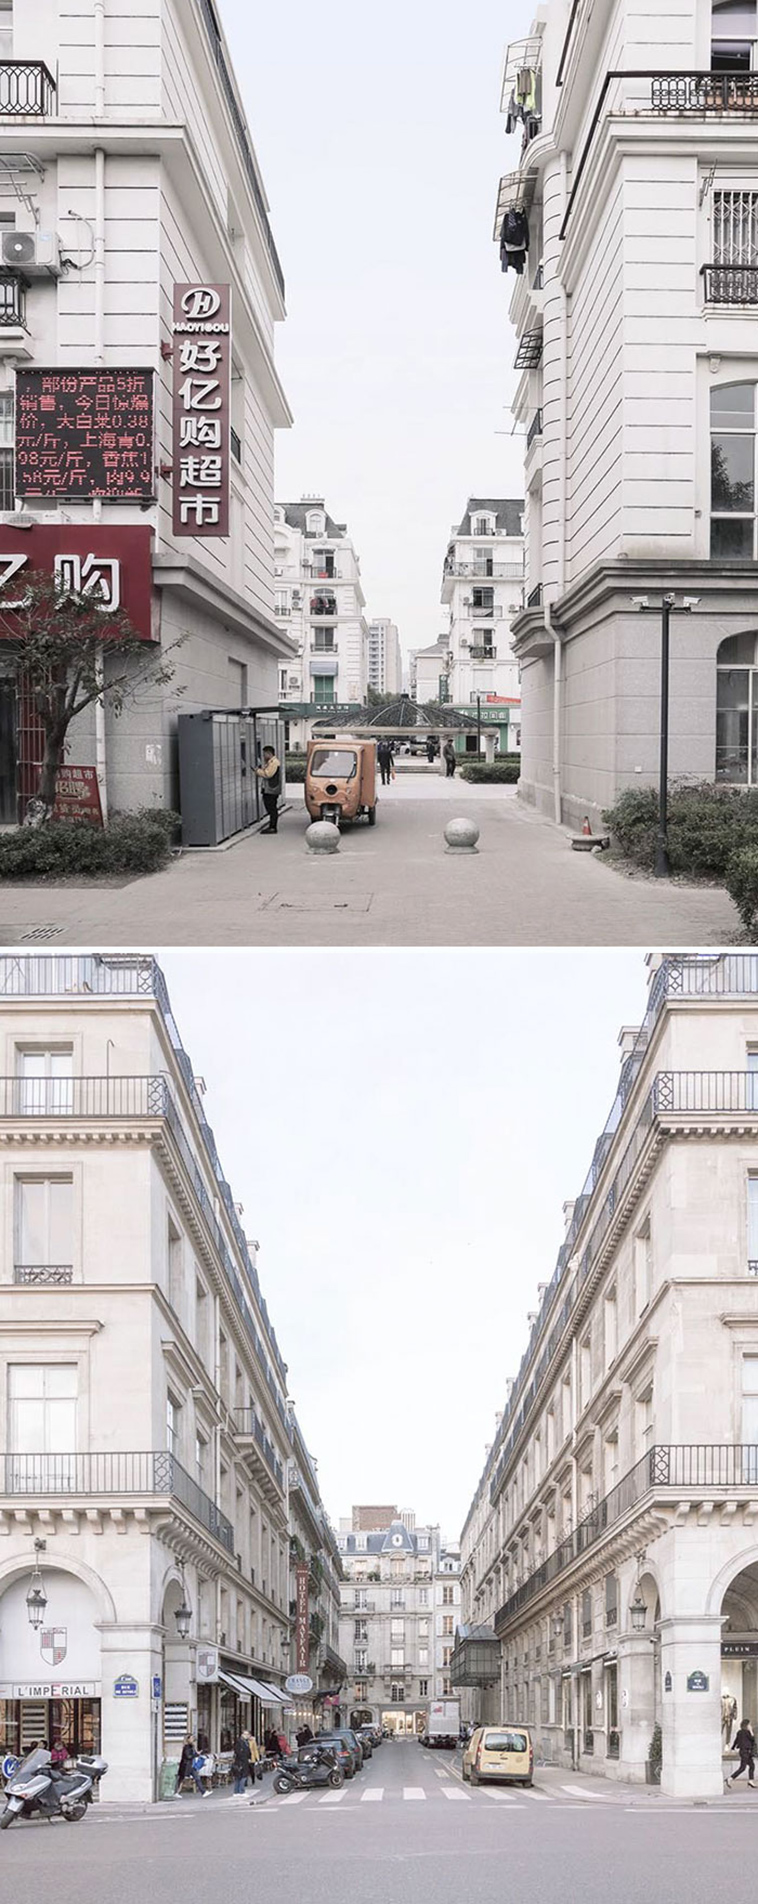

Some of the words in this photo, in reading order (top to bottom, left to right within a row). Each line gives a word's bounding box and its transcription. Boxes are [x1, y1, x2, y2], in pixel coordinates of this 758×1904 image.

[178, 339, 222, 526] 好亿购超市
[18, 1682, 90, 1697] L'IMPERIAL
